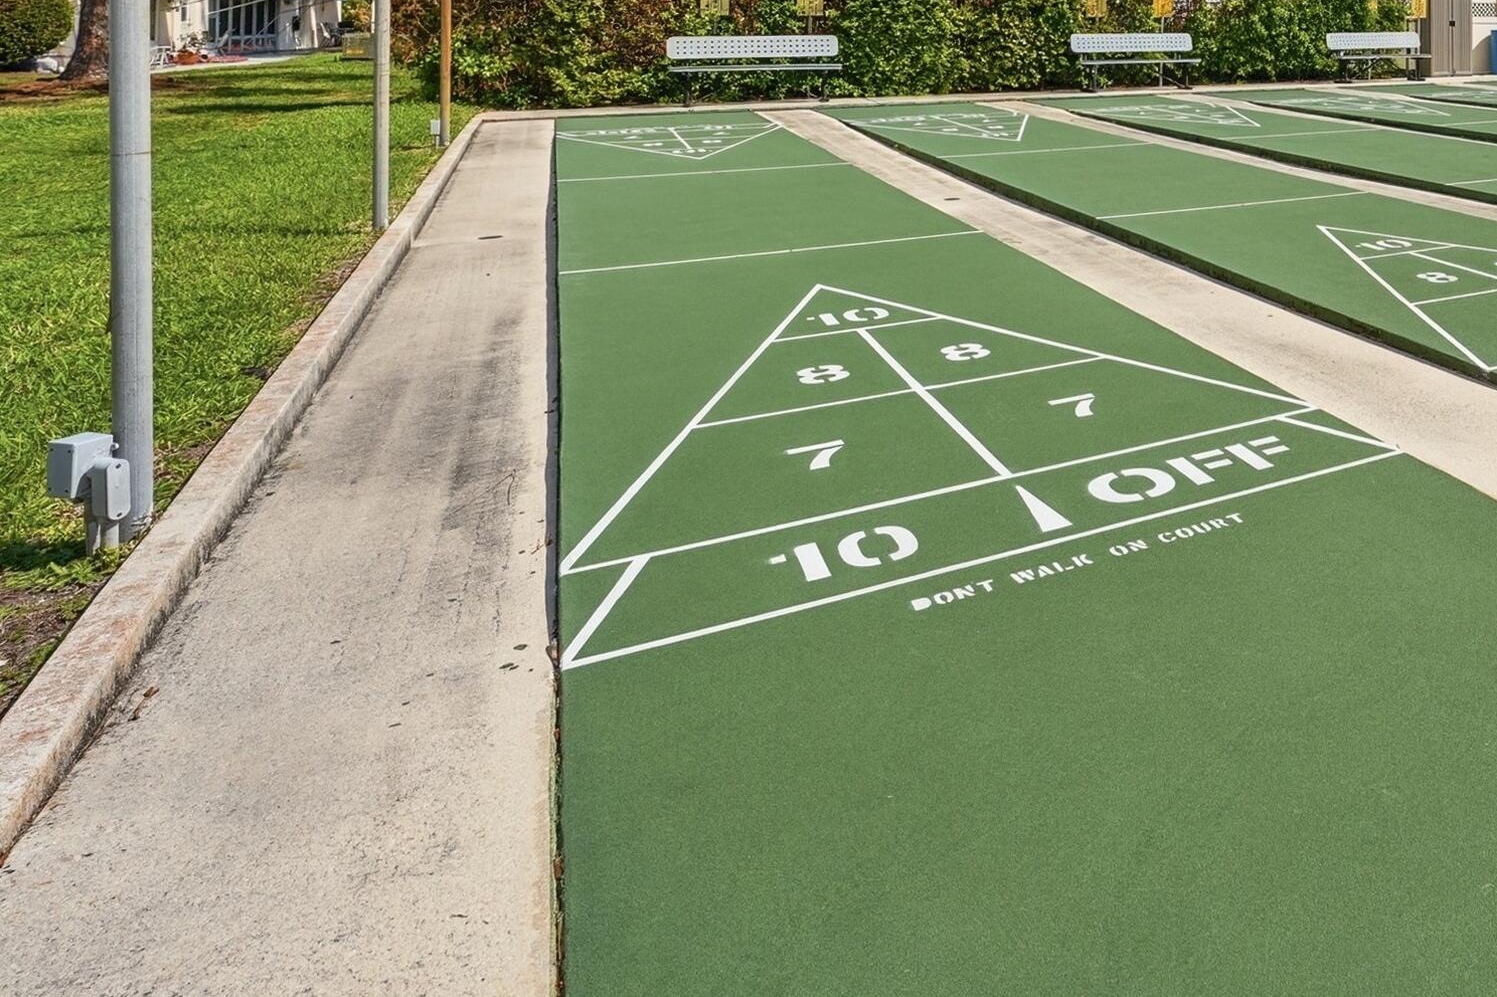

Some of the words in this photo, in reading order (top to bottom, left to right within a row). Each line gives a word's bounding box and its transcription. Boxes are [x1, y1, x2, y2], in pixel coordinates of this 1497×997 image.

[1355, 238, 1413, 251] 10
[1416, 271, 1459, 284] 8
[805, 306, 890, 327] 10
[940, 342, 991, 362] 8
[796, 364, 850, 385] 8
[1047, 392, 1096, 418] 7
[785, 439, 845, 471] 7
[769, 525, 919, 583] 10
[1087, 435, 1291, 504] OFF
[1009, 553, 1094, 584] WALK
[1108, 538, 1149, 557] ON
[1157, 512, 1244, 544] COURT
